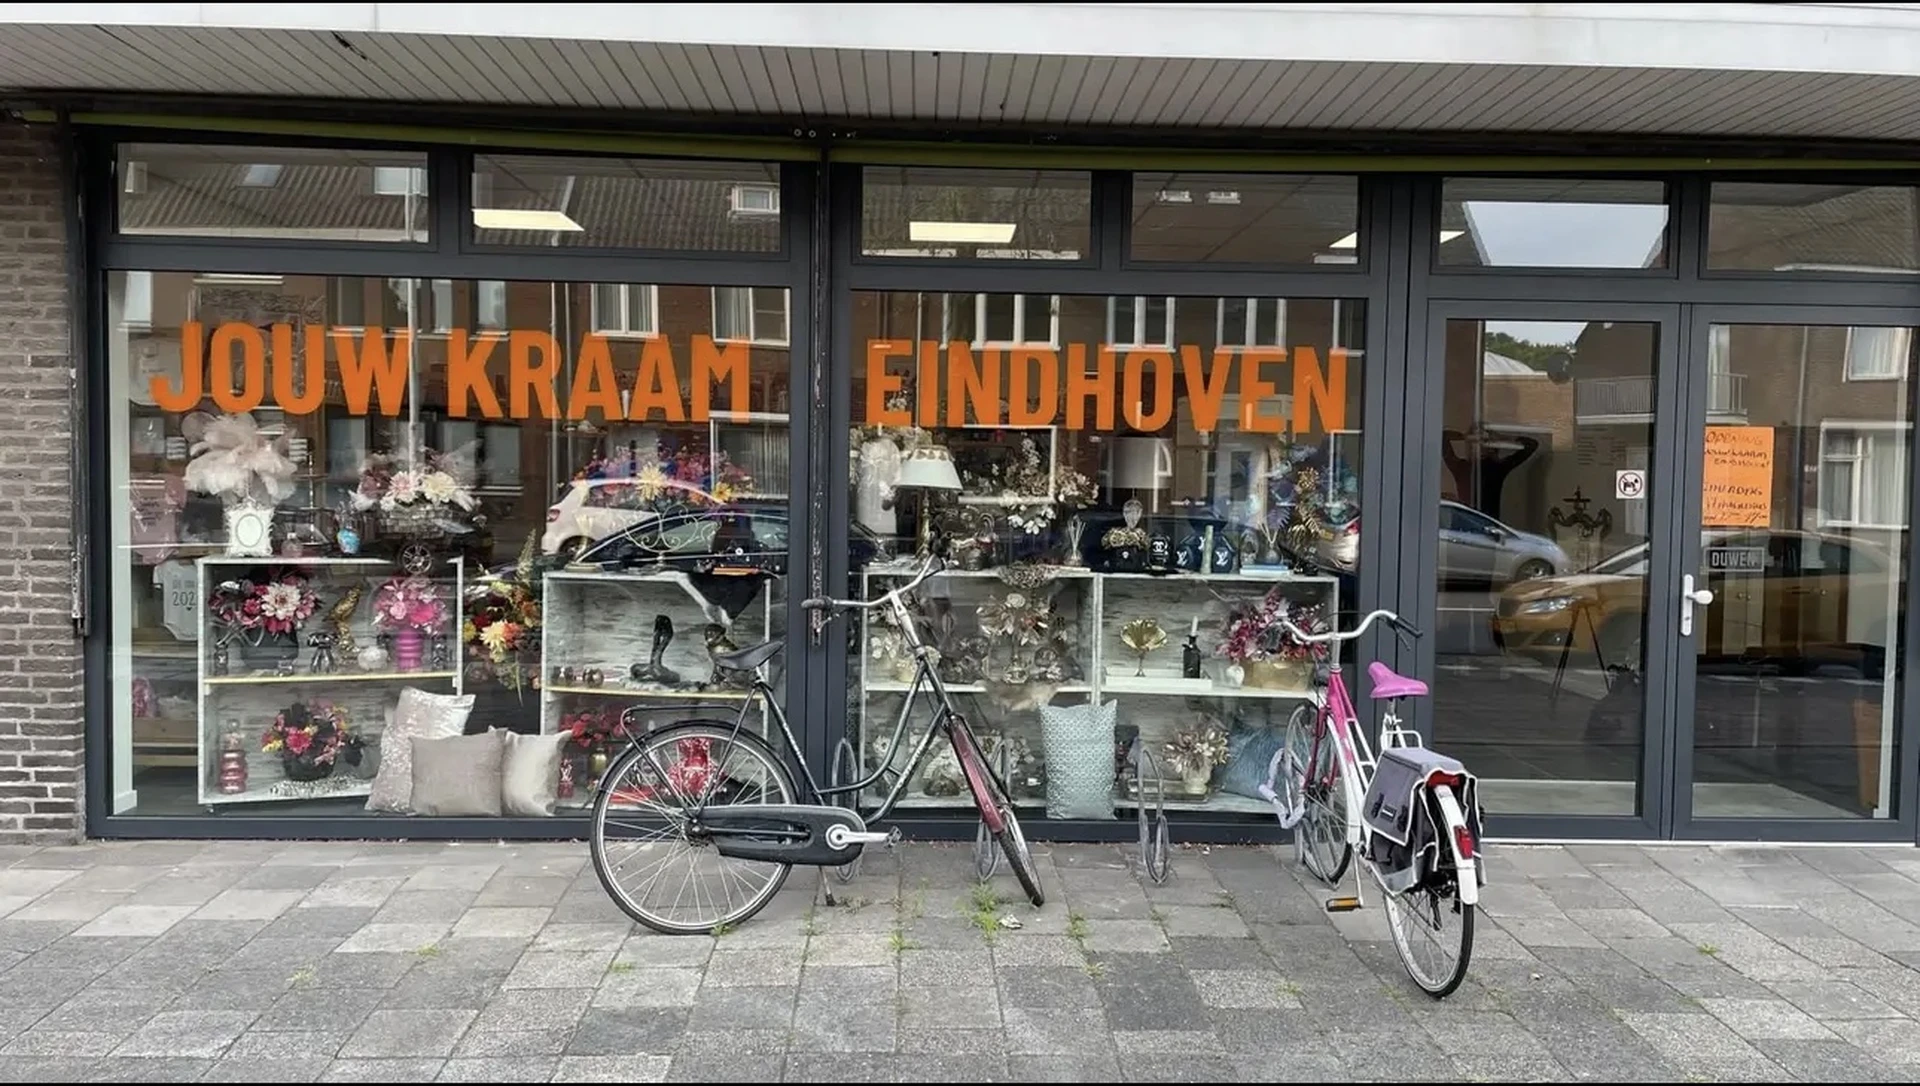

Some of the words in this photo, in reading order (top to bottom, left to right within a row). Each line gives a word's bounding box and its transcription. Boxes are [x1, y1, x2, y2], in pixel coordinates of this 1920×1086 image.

[151, 321, 411, 416] JOUW
[448, 329, 751, 424] KRAAM
[866, 340, 1347, 434] EINDHOVEN
[1712, 552, 1757, 567] DUWEN
[172, 591, 197, 607] 202
